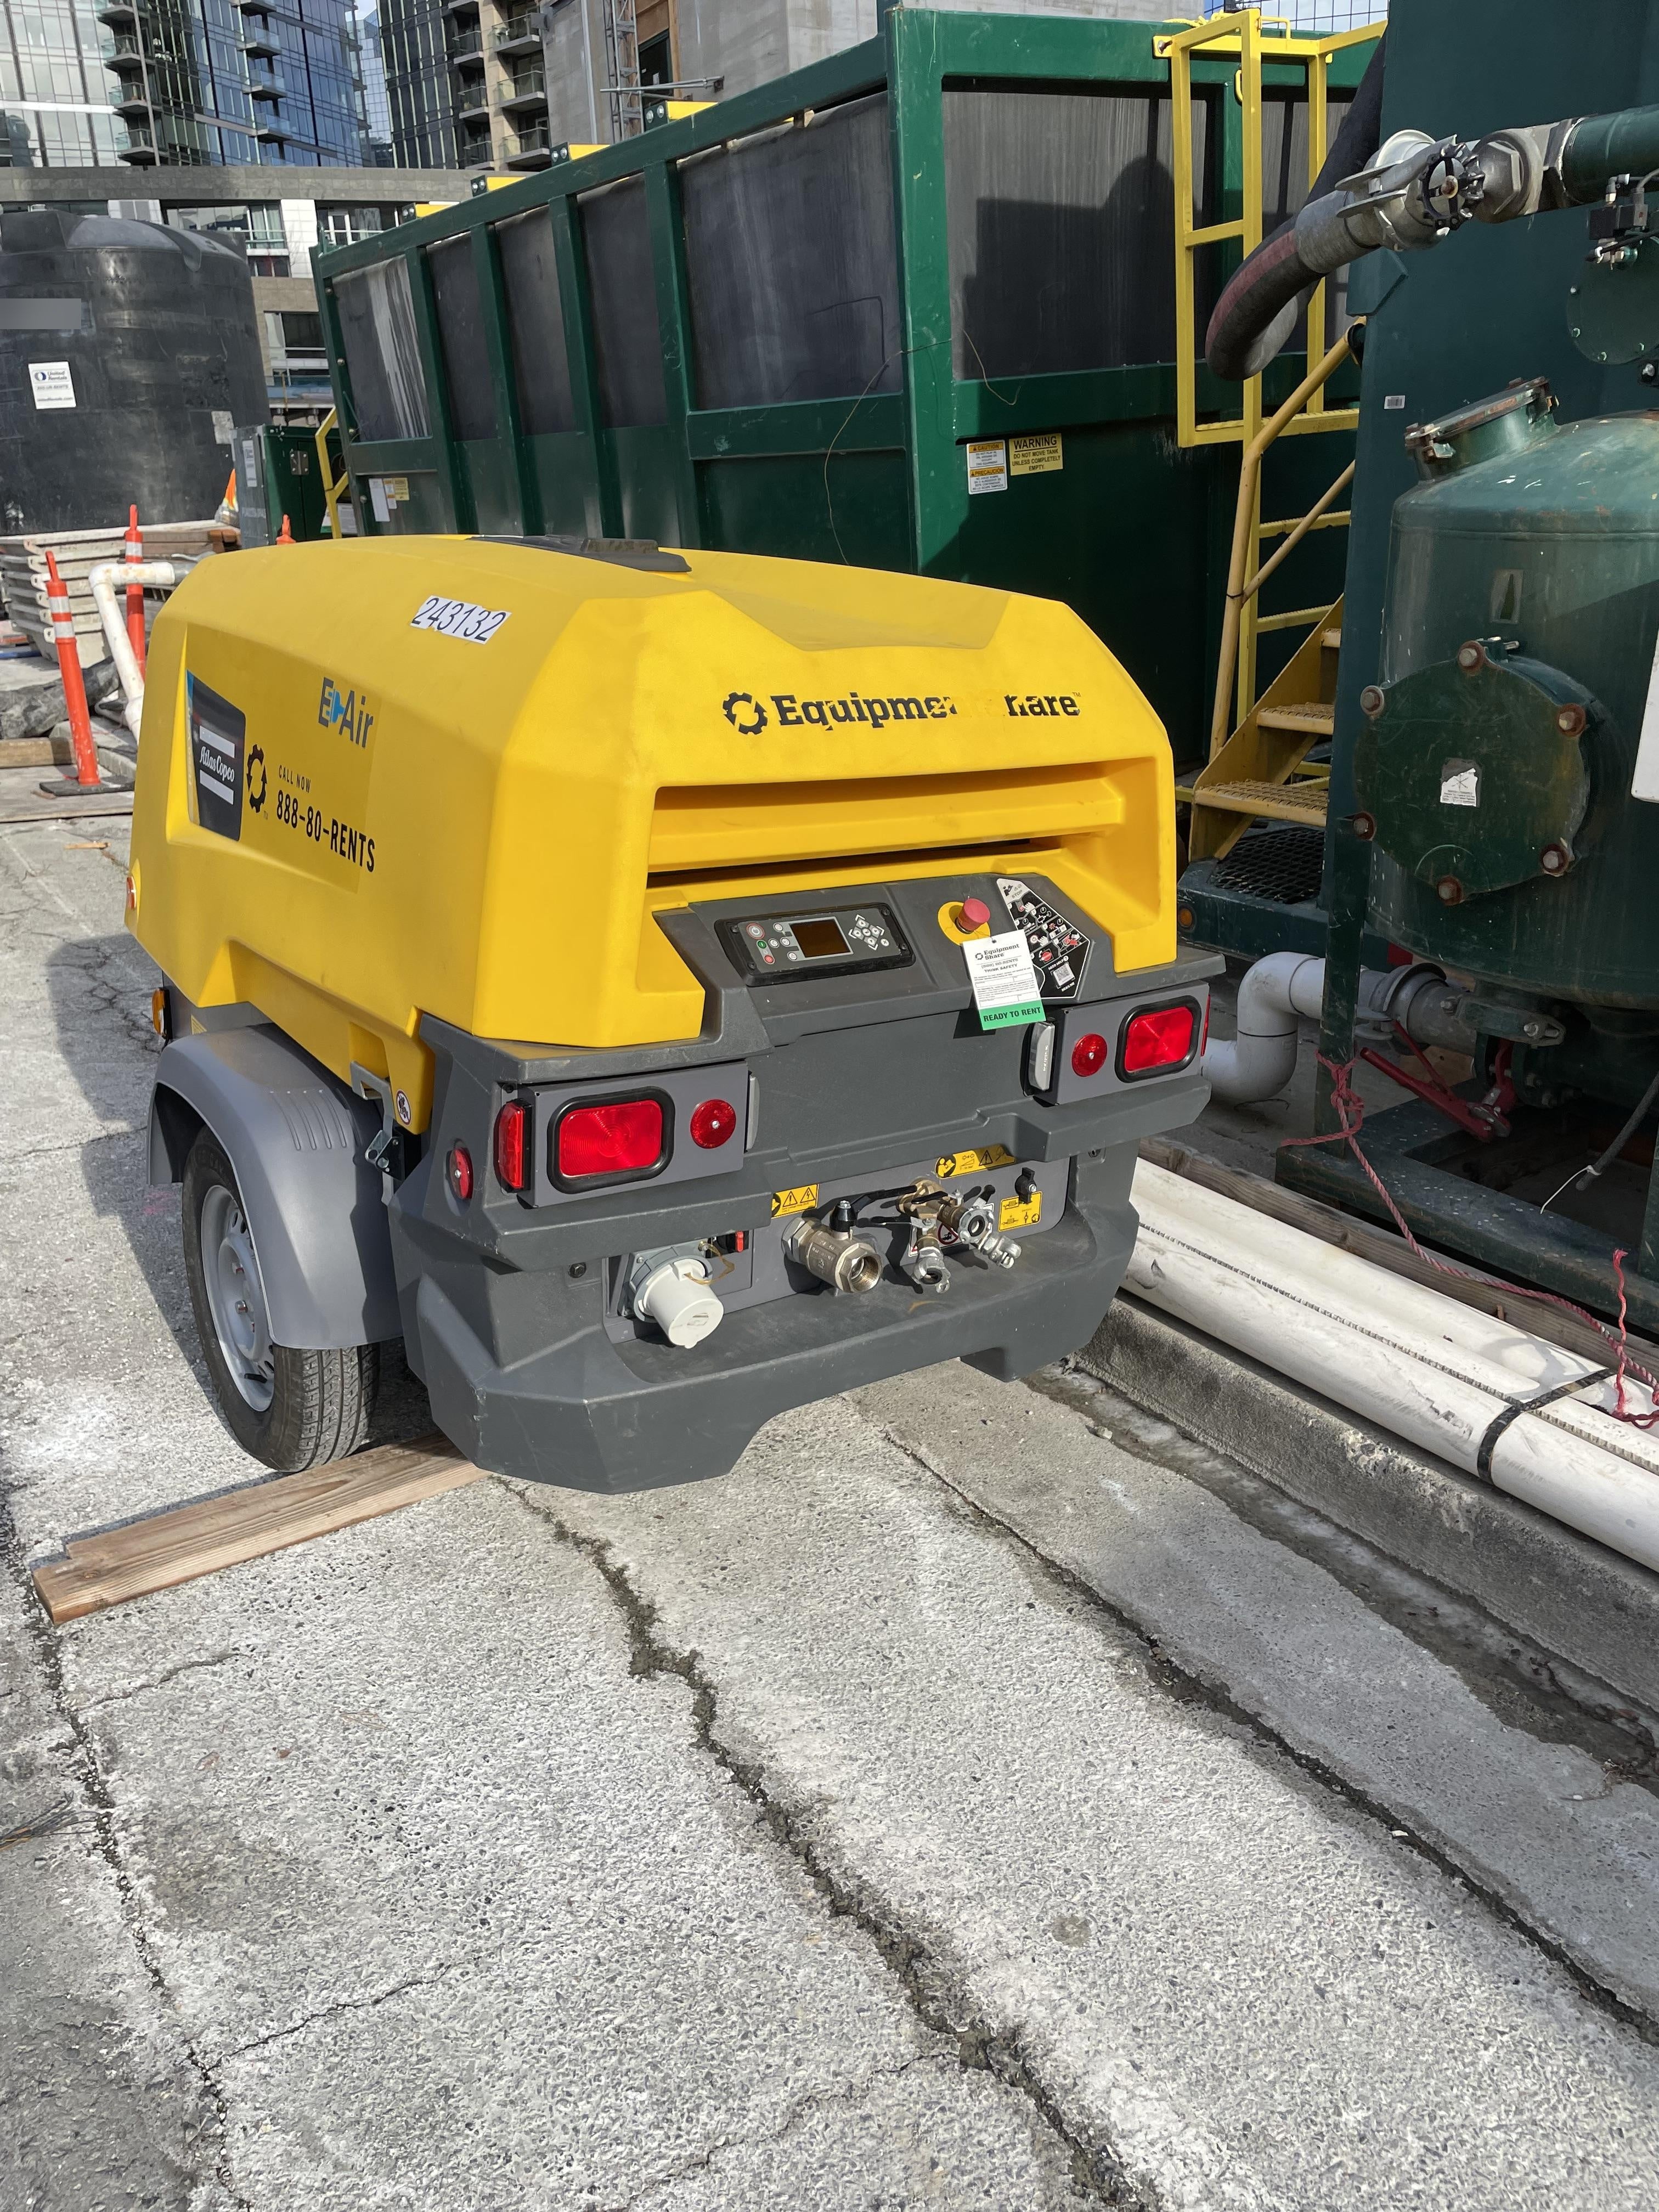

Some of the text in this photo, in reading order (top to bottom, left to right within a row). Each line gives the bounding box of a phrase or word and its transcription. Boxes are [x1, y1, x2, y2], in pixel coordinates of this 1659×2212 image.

[1013, 436, 1057, 450] WARNING
[1031, 455, 1061, 464] COMPLETELY
[411, 597, 506, 642] 243132
[278, 764, 311, 794] CALL NOW
[276, 789, 376, 873] 888-80-RENTS
[984, 944, 1020, 955] Equipment
[983, 1012, 1008, 1022] READY
[1022, 1007, 1041, 1015] RENT
